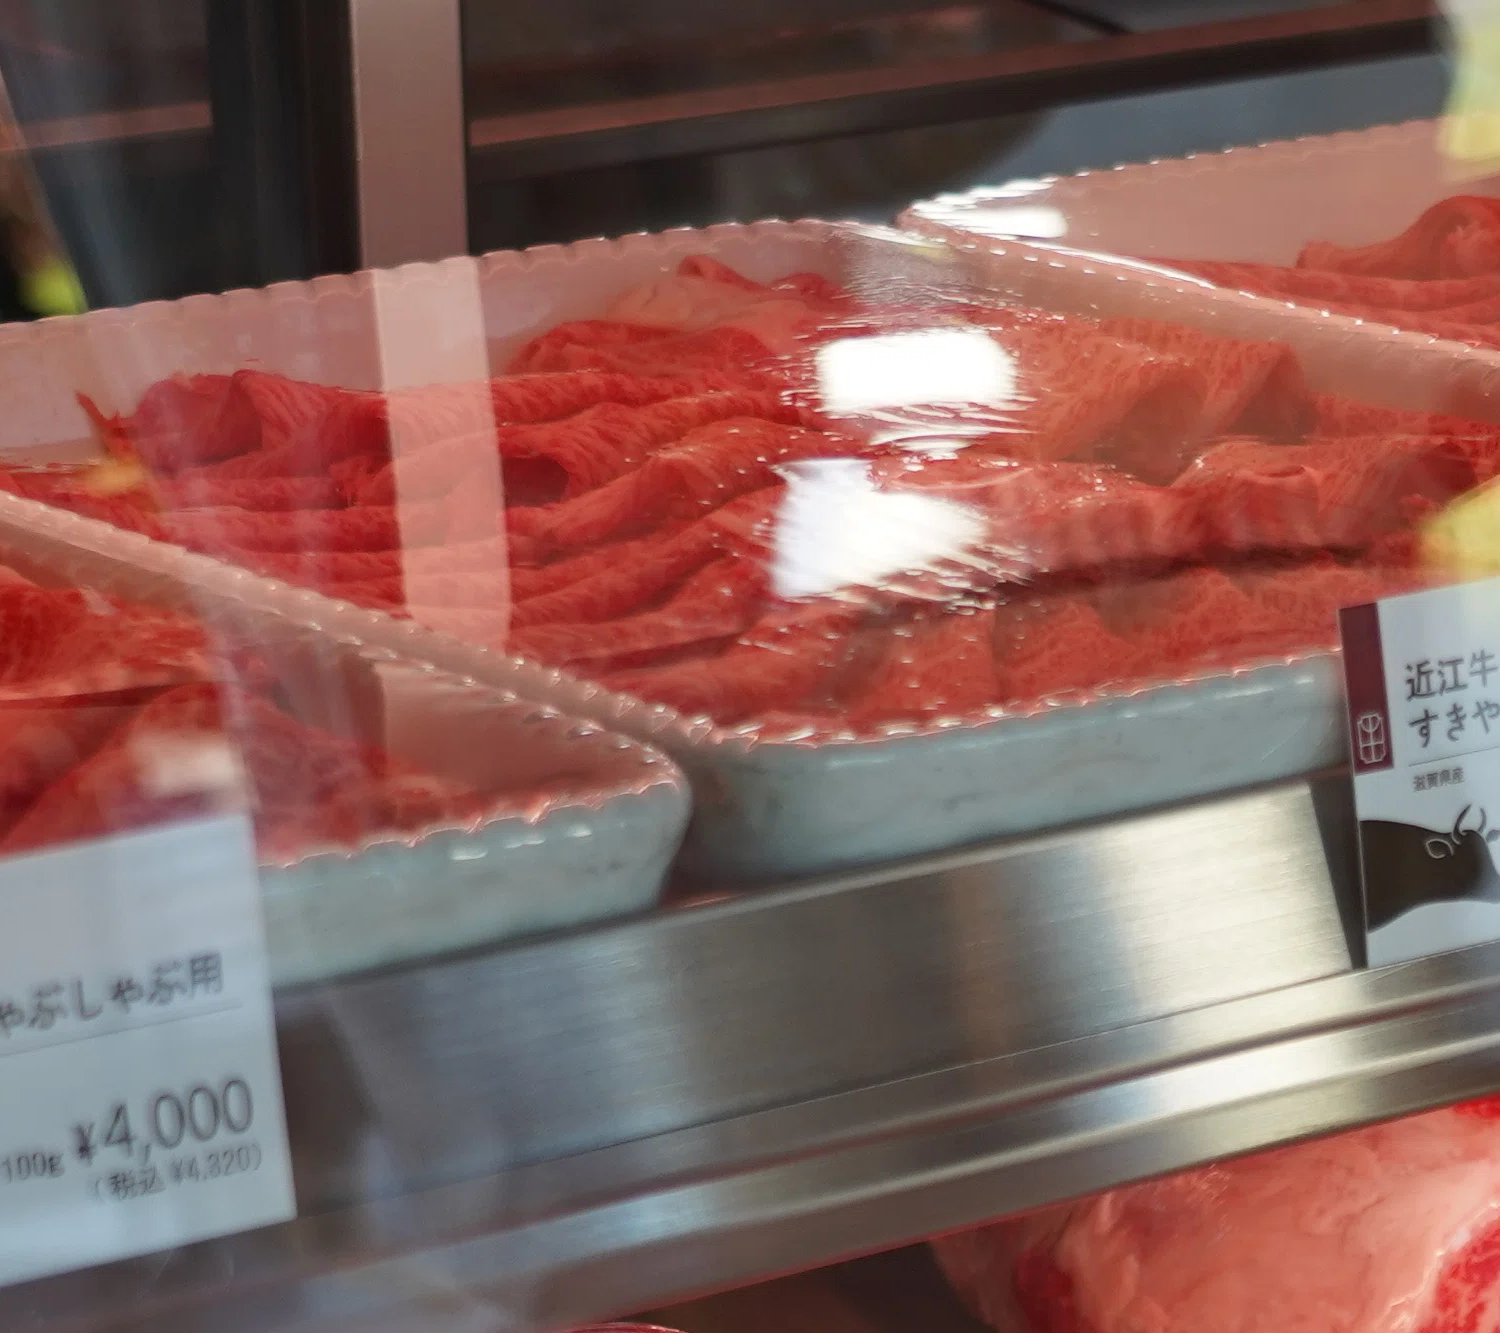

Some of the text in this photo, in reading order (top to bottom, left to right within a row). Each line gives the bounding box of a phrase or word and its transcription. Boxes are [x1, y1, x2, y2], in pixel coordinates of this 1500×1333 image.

[1404, 648, 1499, 701] 近江牛
[0, 1078, 253, 1184] 100g ¥4,000
